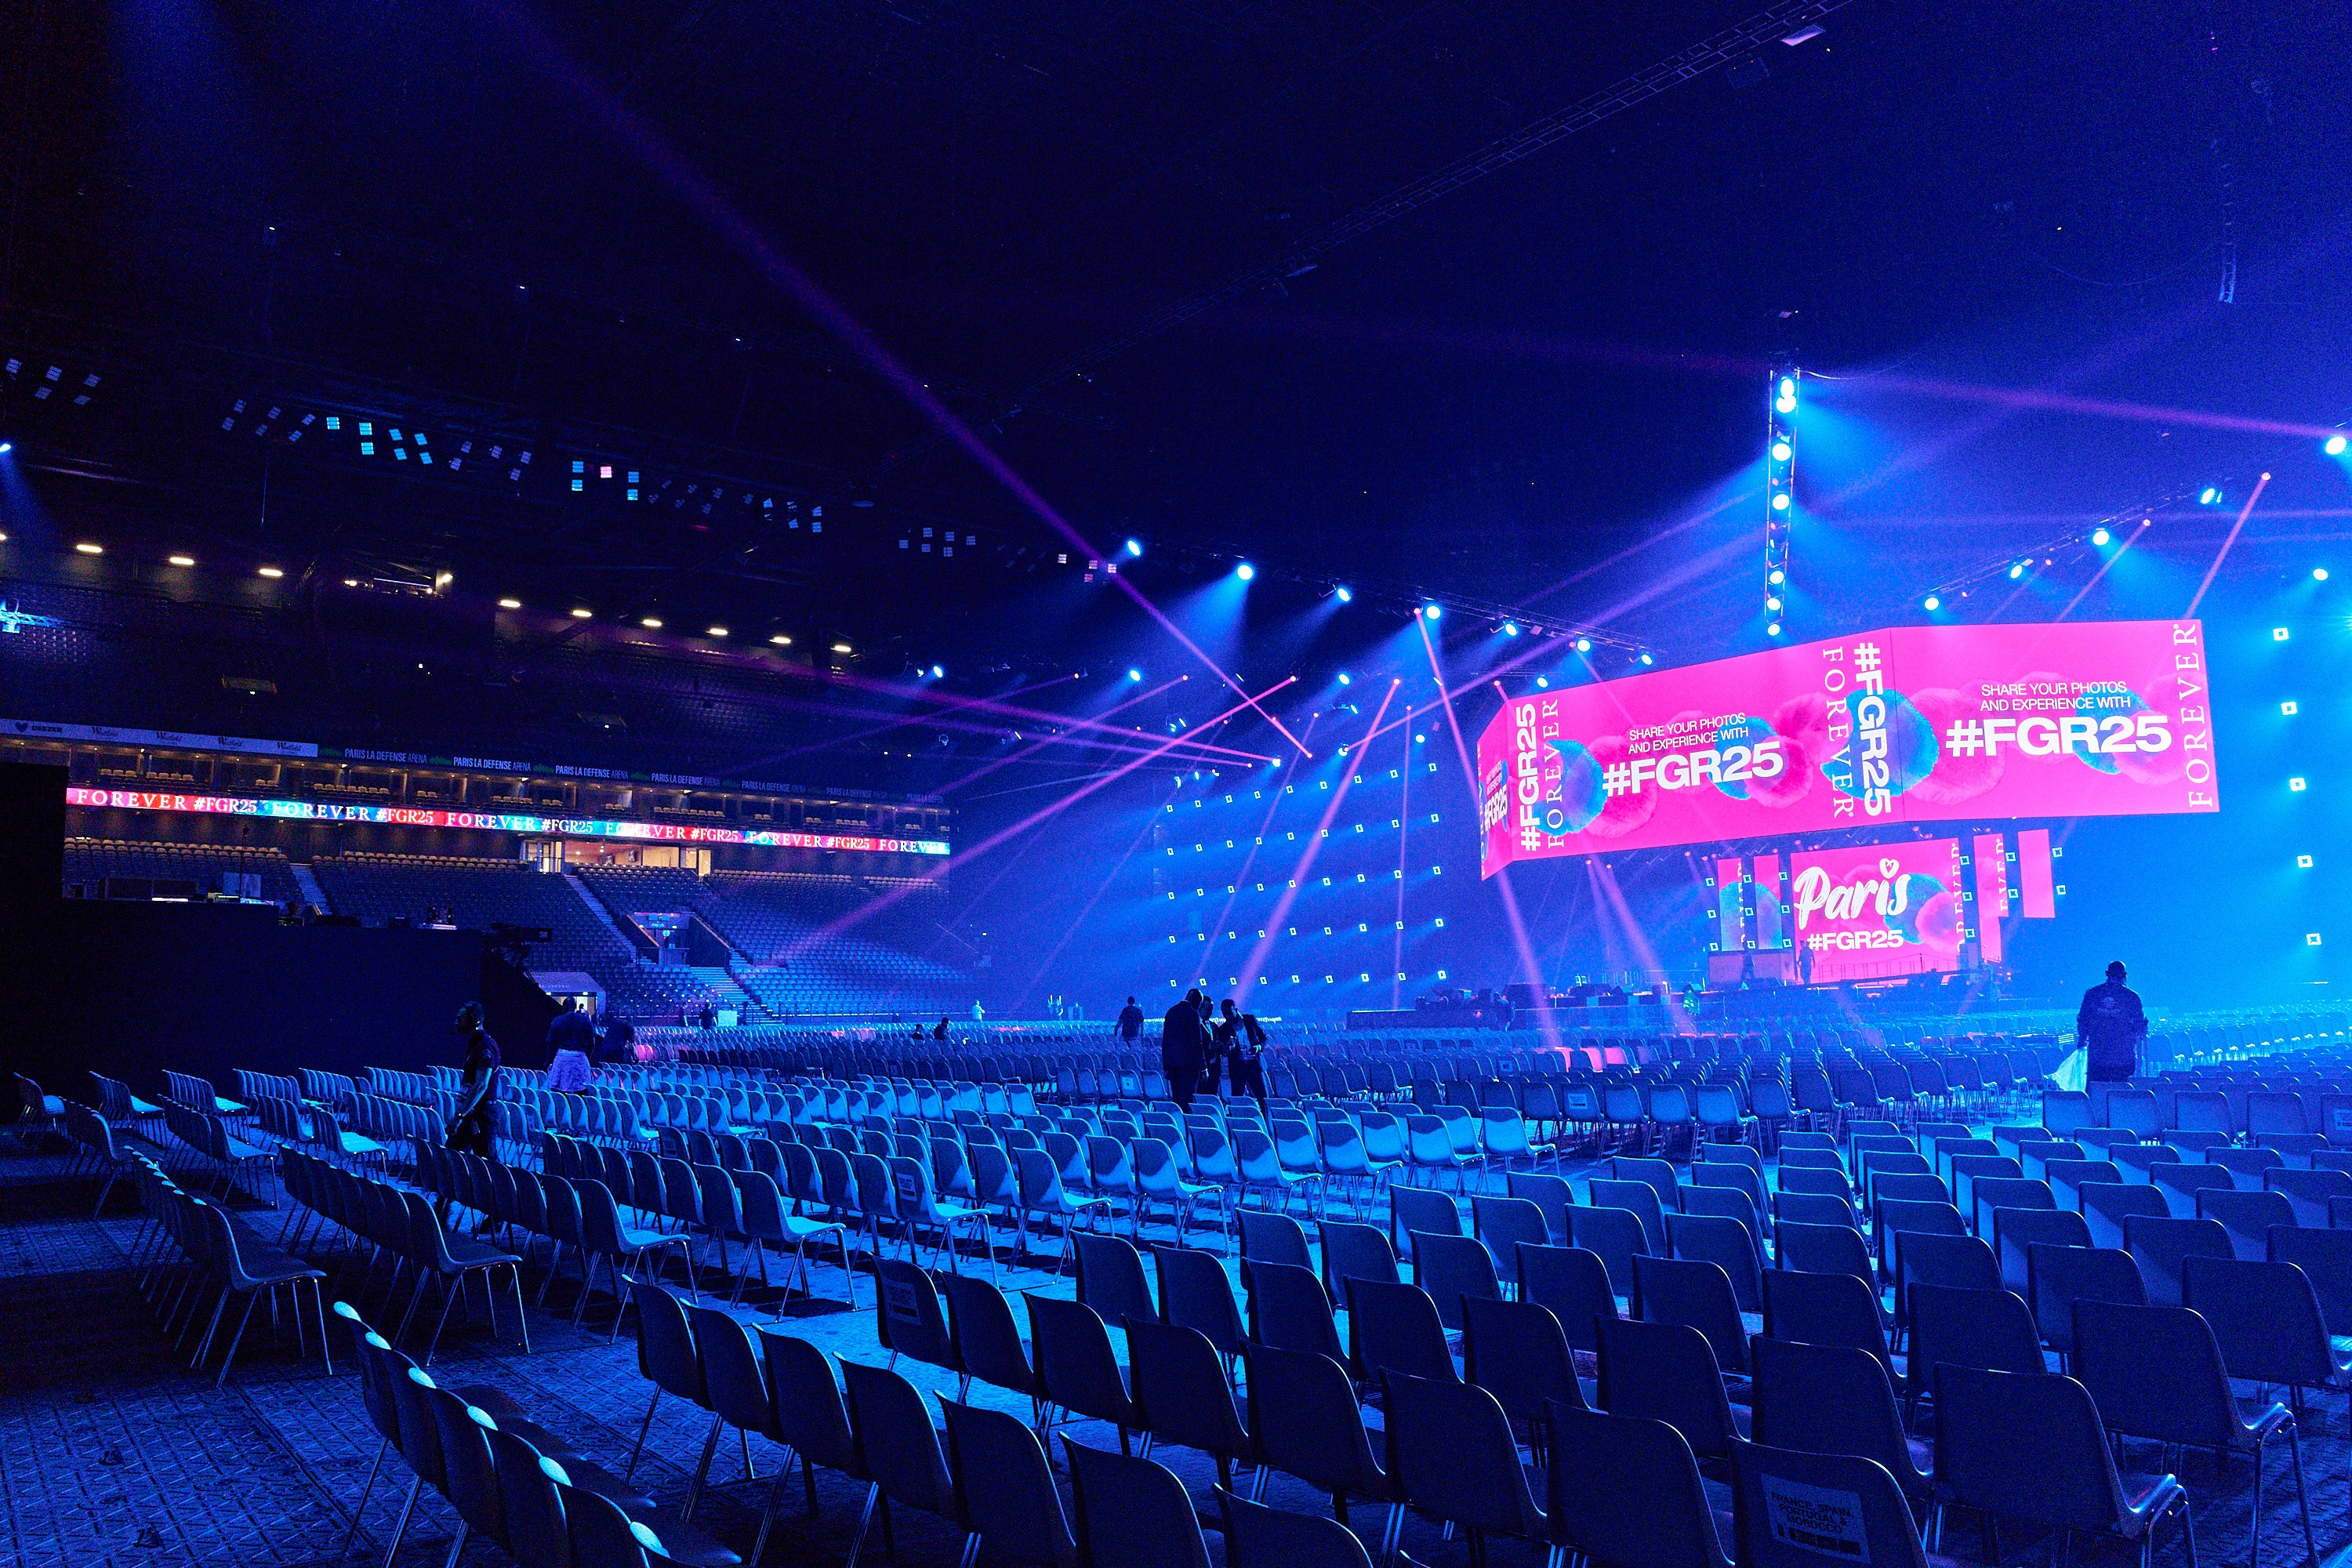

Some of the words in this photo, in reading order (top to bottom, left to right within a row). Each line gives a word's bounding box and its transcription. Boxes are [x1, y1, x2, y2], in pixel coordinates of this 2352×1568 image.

[1981, 684, 2027, 697] SHARE
[2029, 682, 2068, 695] YOUR
[2071, 681, 2127, 694] PHOTOS
[1980, 699, 2009, 712] AND
[2012, 696, 2094, 711] EXPERIENCE
[2096, 695, 2131, 709] WITH
[2172, 623, 2213, 808] FOREVER
[1628, 741, 1651, 754] AND
[1653, 733, 1719, 751] EXPERIENCE
[1719, 726, 1749, 740] WITH
[1629, 725, 1665, 741] SHARE
[1666, 720, 1697, 735] YOUR
[1699, 713, 1746, 728] PHOTOS
[1822, 645, 1854, 818] FOREVER
[1853, 642, 1892, 816] #FGR25
[1945, 715, 2172, 757] #FGR25
[345, 748, 365, 759] PARIS
[366, 750, 375, 760] LA
[376, 750, 406, 762] DEFENSE
[408, 753, 427, 764] ARENA
[453, 757, 474, 767] PARIS
[474, 758, 482, 768] LA
[484, 759, 511, 770] DEFENSE
[513, 761, 531, 771] ARENA
[1602, 740, 1784, 797] #FGR25
[555, 764, 574, 775] PARIS
[575, 766, 583, 776] LA
[583, 768, 610, 779] DEFENSE
[611, 770, 628, 779] ARENA
[652, 772, 669, 782] PARIS
[670, 774, 677, 783] LA
[678, 775, 702, 786] DEFENSE
[1515, 703, 1541, 851] #FGR25
[1542, 699, 1564, 848] FOREVER
[741, 780, 758, 789] PARIS
[759, 782, 765, 790] LA
[767, 782, 790, 793] DEFENSE
[76, 789, 187, 810] FOREVER
[193, 797, 258, 813] #FGR25
[272, 801, 370, 821] FOREVER
[376, 808, 434, 823] #FGR25
[447, 812, 535, 830] FOREVER
[541, 818, 593, 833] #FGR25
[606, 822, 686, 839] FOREVER
[691, 828, 739, 842] #FGR25
[750, 831, 822, 848] FOREVER
[826, 837, 870, 849] #FGR25
[880, 840, 948, 854] FOREVER
[1484, 784, 1508, 832] #FGR25
[1794, 858, 1911, 930] Paris
[1806, 930, 1904, 951] #FGR25
[1779, 1503, 1835, 1523] PORTUGAL
[1839, 1516, 1847, 1526] &
[1787, 1515, 1842, 1534] MOROCCO
